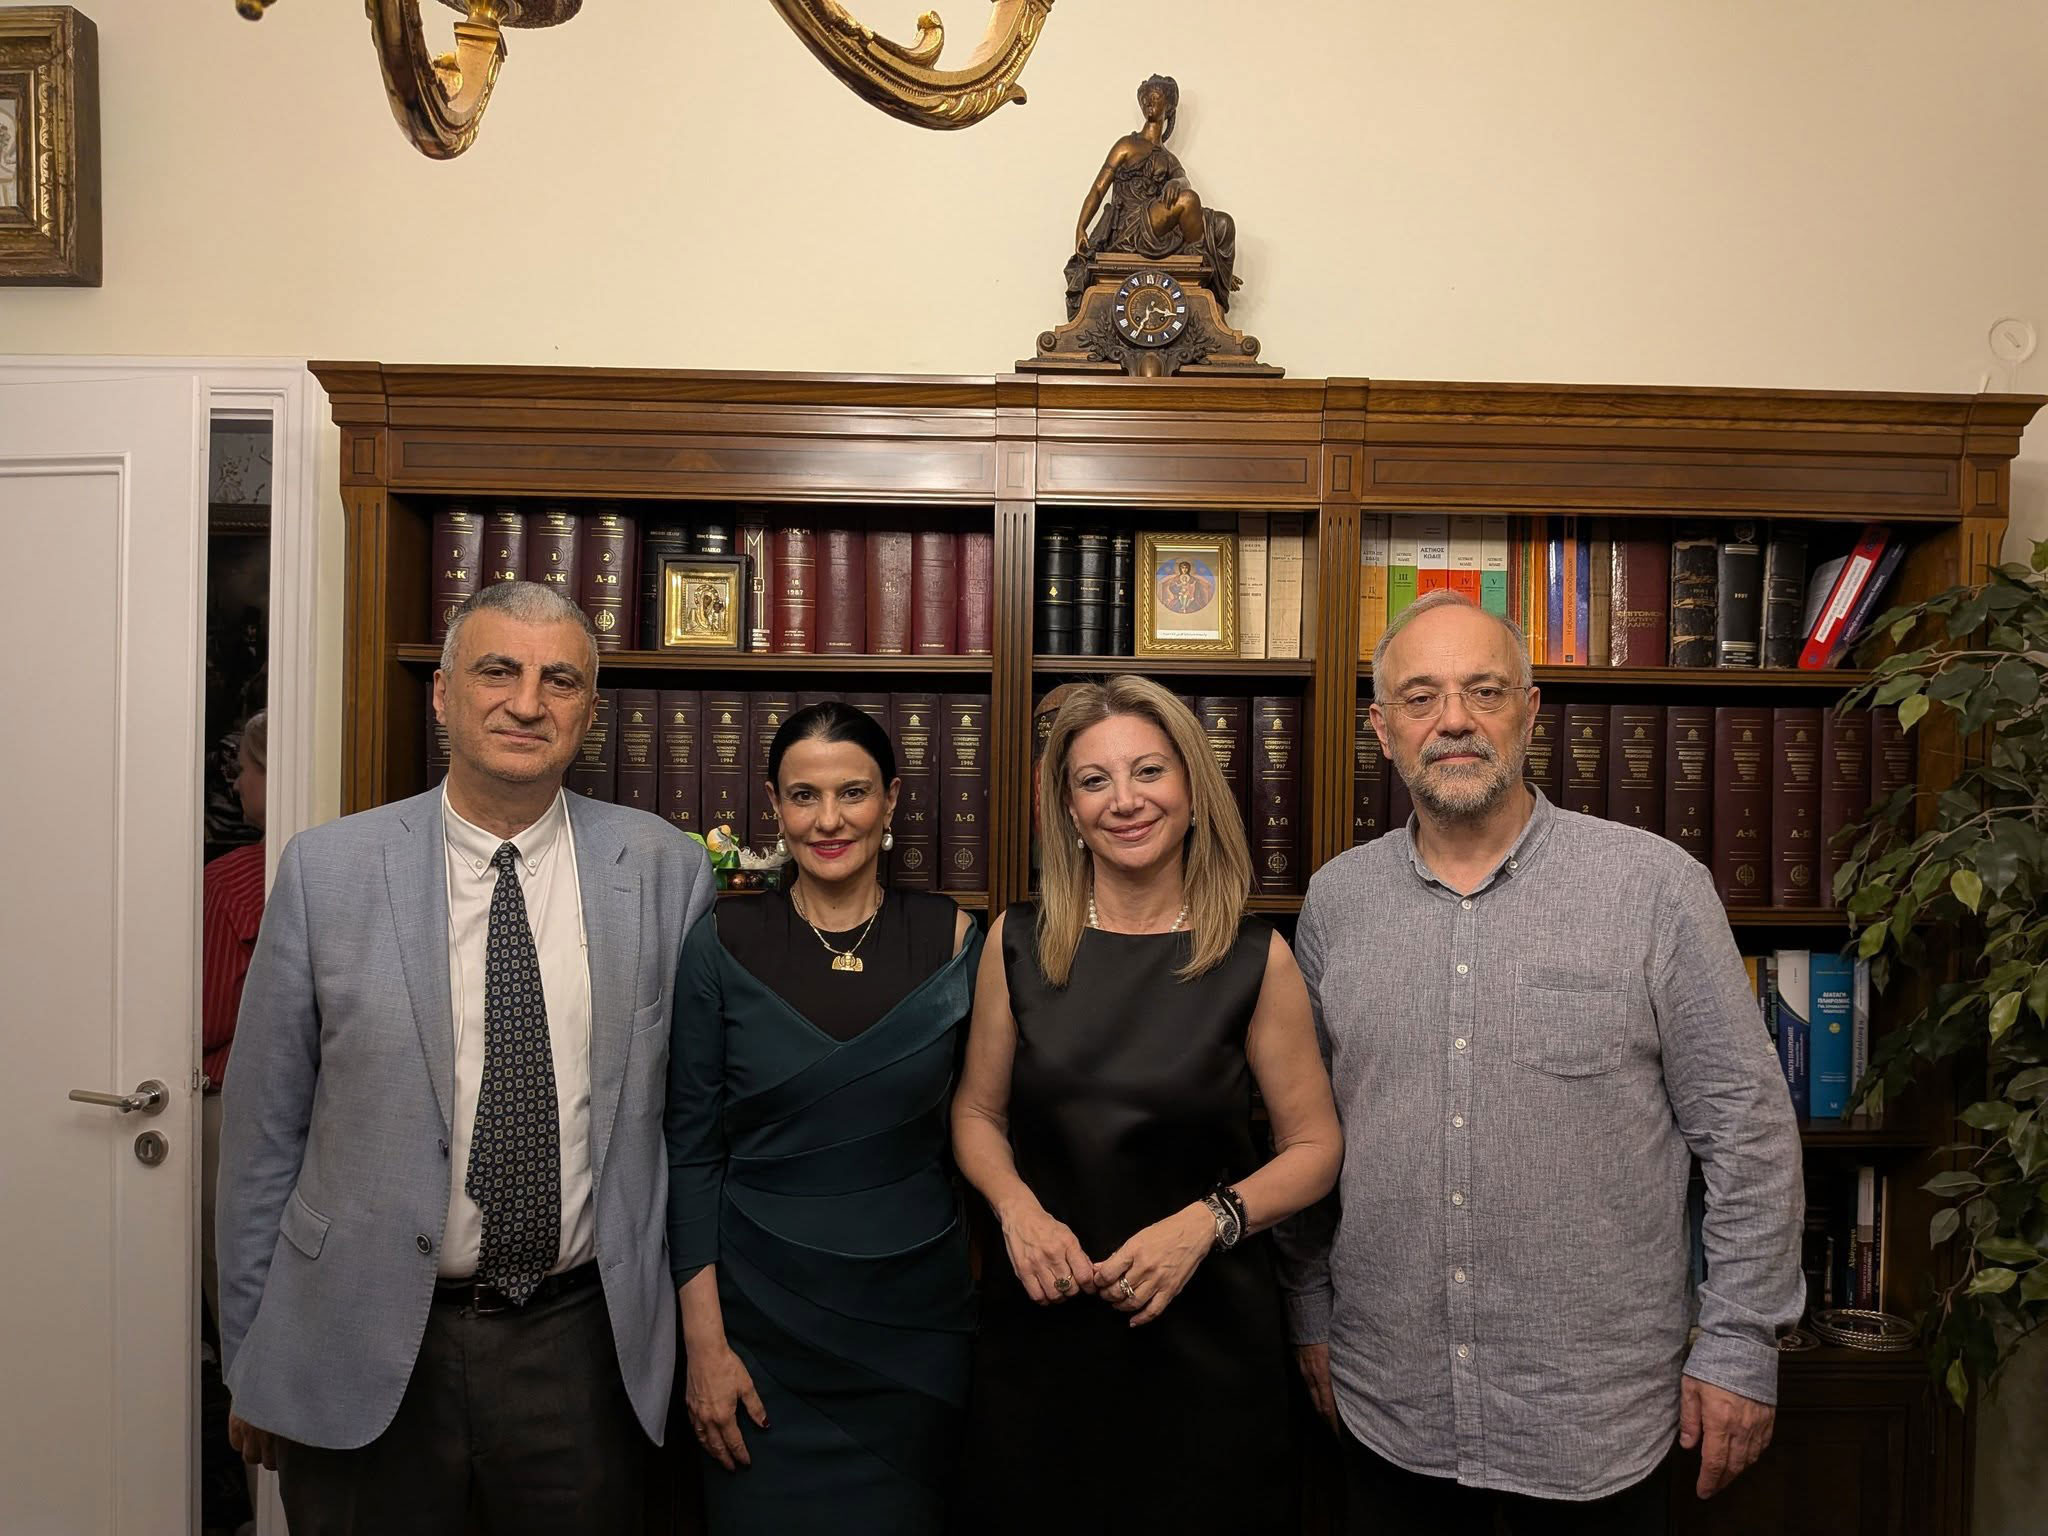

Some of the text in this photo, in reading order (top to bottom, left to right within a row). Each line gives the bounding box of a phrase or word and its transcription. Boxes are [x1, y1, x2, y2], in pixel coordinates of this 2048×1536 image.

[452, 549, 459, 558] 1
[500, 549, 508, 558] 2
[551, 552, 558, 561] 1
[603, 553, 611, 561] 2
[1399, 573, 1408, 581] III
[1426, 579, 1438, 588] IV
[586, 787, 593, 796] 2
[633, 790, 639, 798] 1
[675, 790, 683, 798] 2
[721, 791, 728, 799] 1
[911, 792, 917, 800] 1
[961, 792, 968, 801] 2
[1274, 795, 1281, 804] 2
[1363, 797, 1369, 805] 2
[1582, 805, 1589, 813] 2
[1635, 806, 1641, 814] 1
[1688, 807, 1695, 815] 2
[1744, 808, 1750, 816] 1
[1798, 808, 1805, 816] 2
